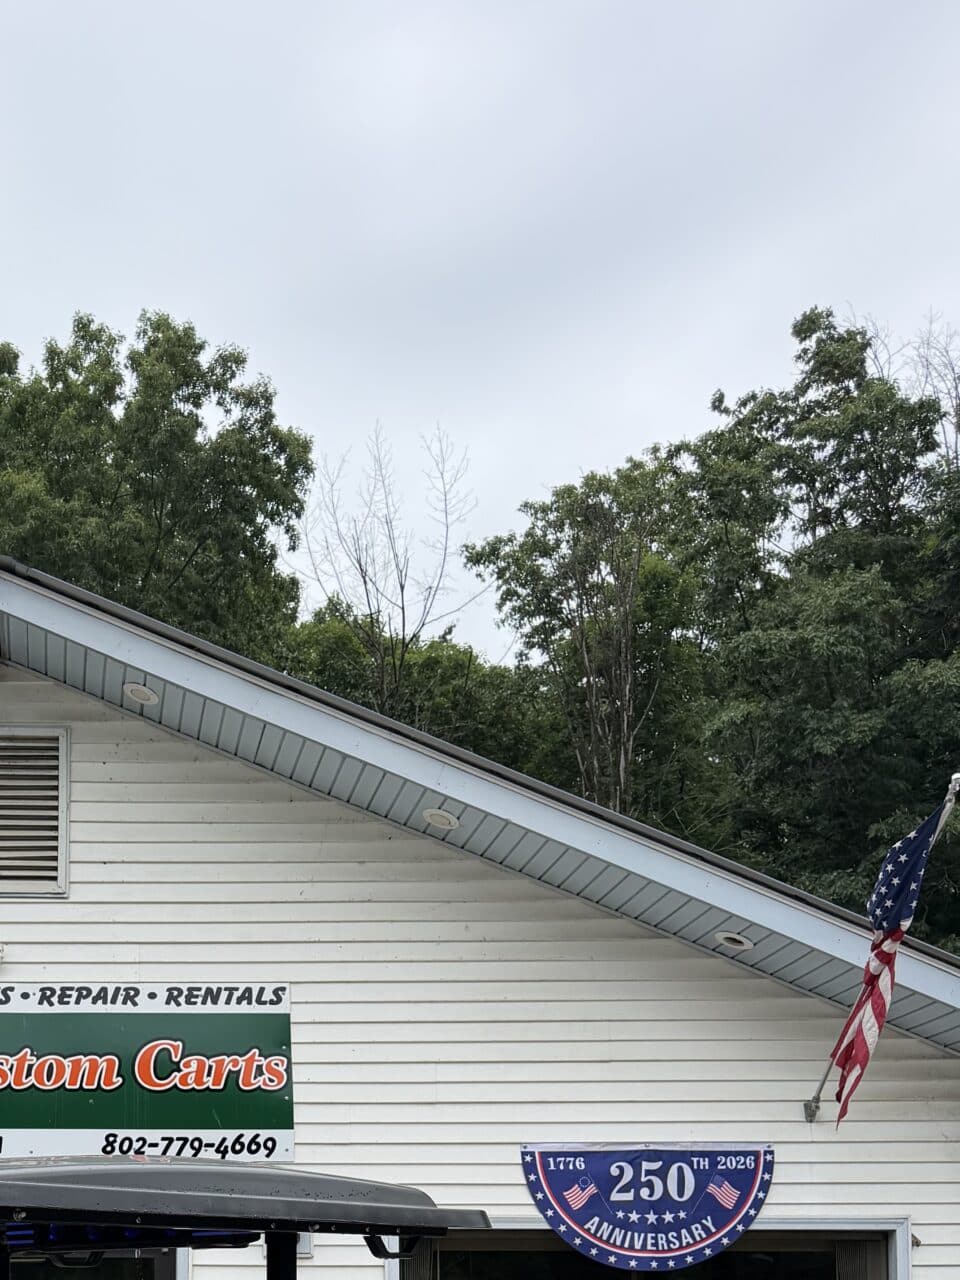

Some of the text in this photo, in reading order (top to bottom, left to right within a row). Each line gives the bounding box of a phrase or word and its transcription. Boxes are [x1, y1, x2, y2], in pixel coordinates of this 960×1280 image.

[39, 986, 140, 1007] REPAIR
[164, 986, 286, 1007] RENTALS
[134, 1040, 287, 1091] Carts
[100, 1132, 277, 1159] 802-779-4669
[547, 1157, 585, 1170] 1776
[717, 1156, 755, 1170] 2026
[583, 1215, 717, 1250] ANNIVERSARY
